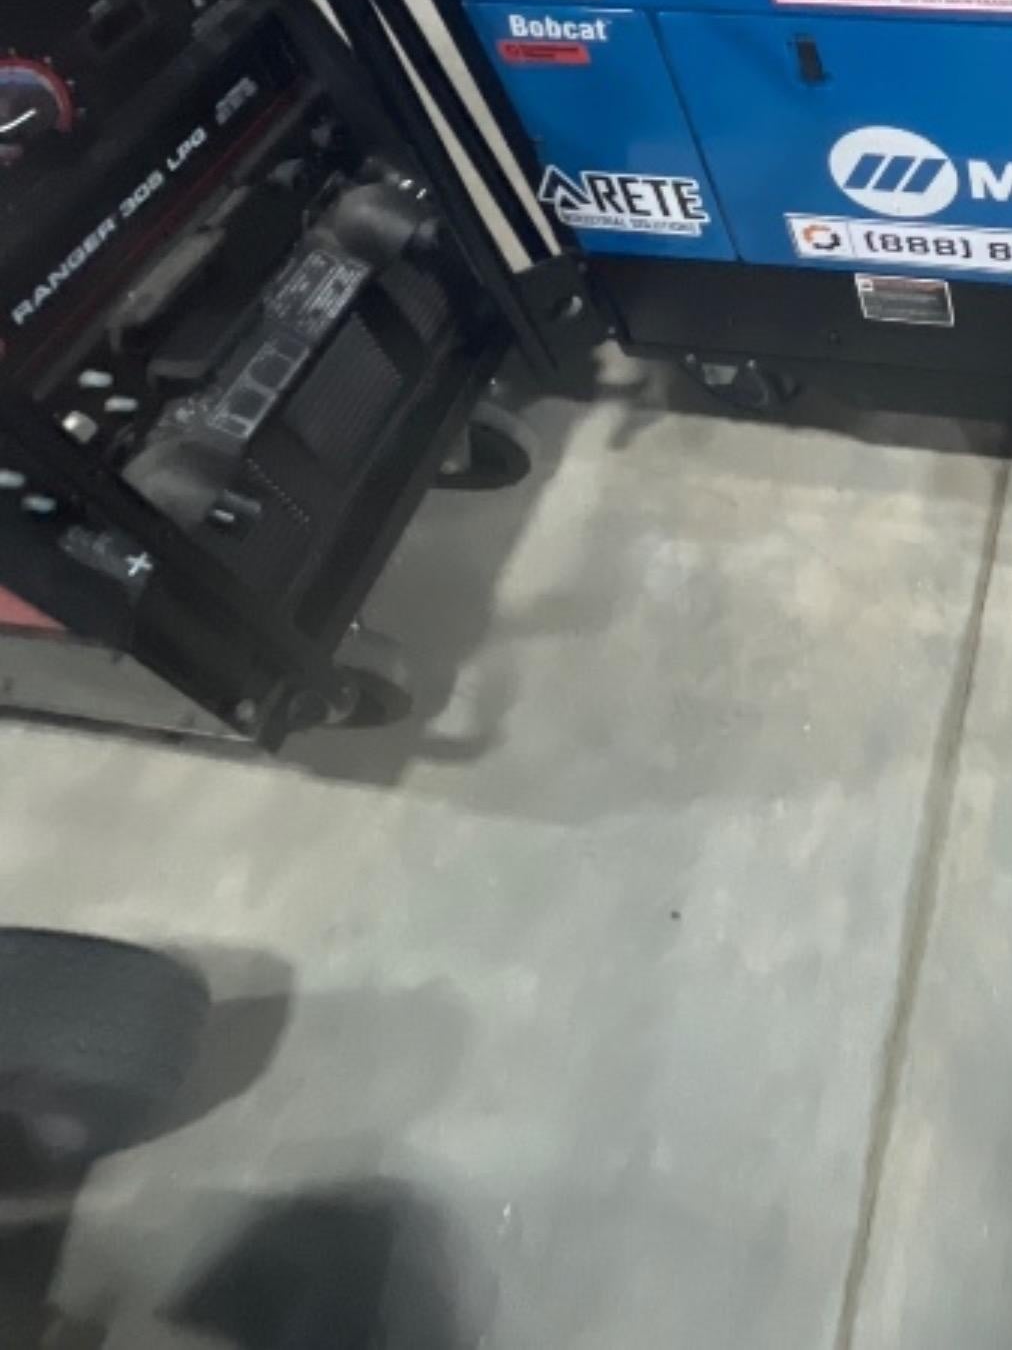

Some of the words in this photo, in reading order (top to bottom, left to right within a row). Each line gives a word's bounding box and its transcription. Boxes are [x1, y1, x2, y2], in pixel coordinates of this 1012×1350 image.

[508, 14, 608, 41] Bobcat
[540, 166, 707, 221] ARETE
[864, 230, 972, 259] (888)
[11, 217, 117, 325] RANGER
